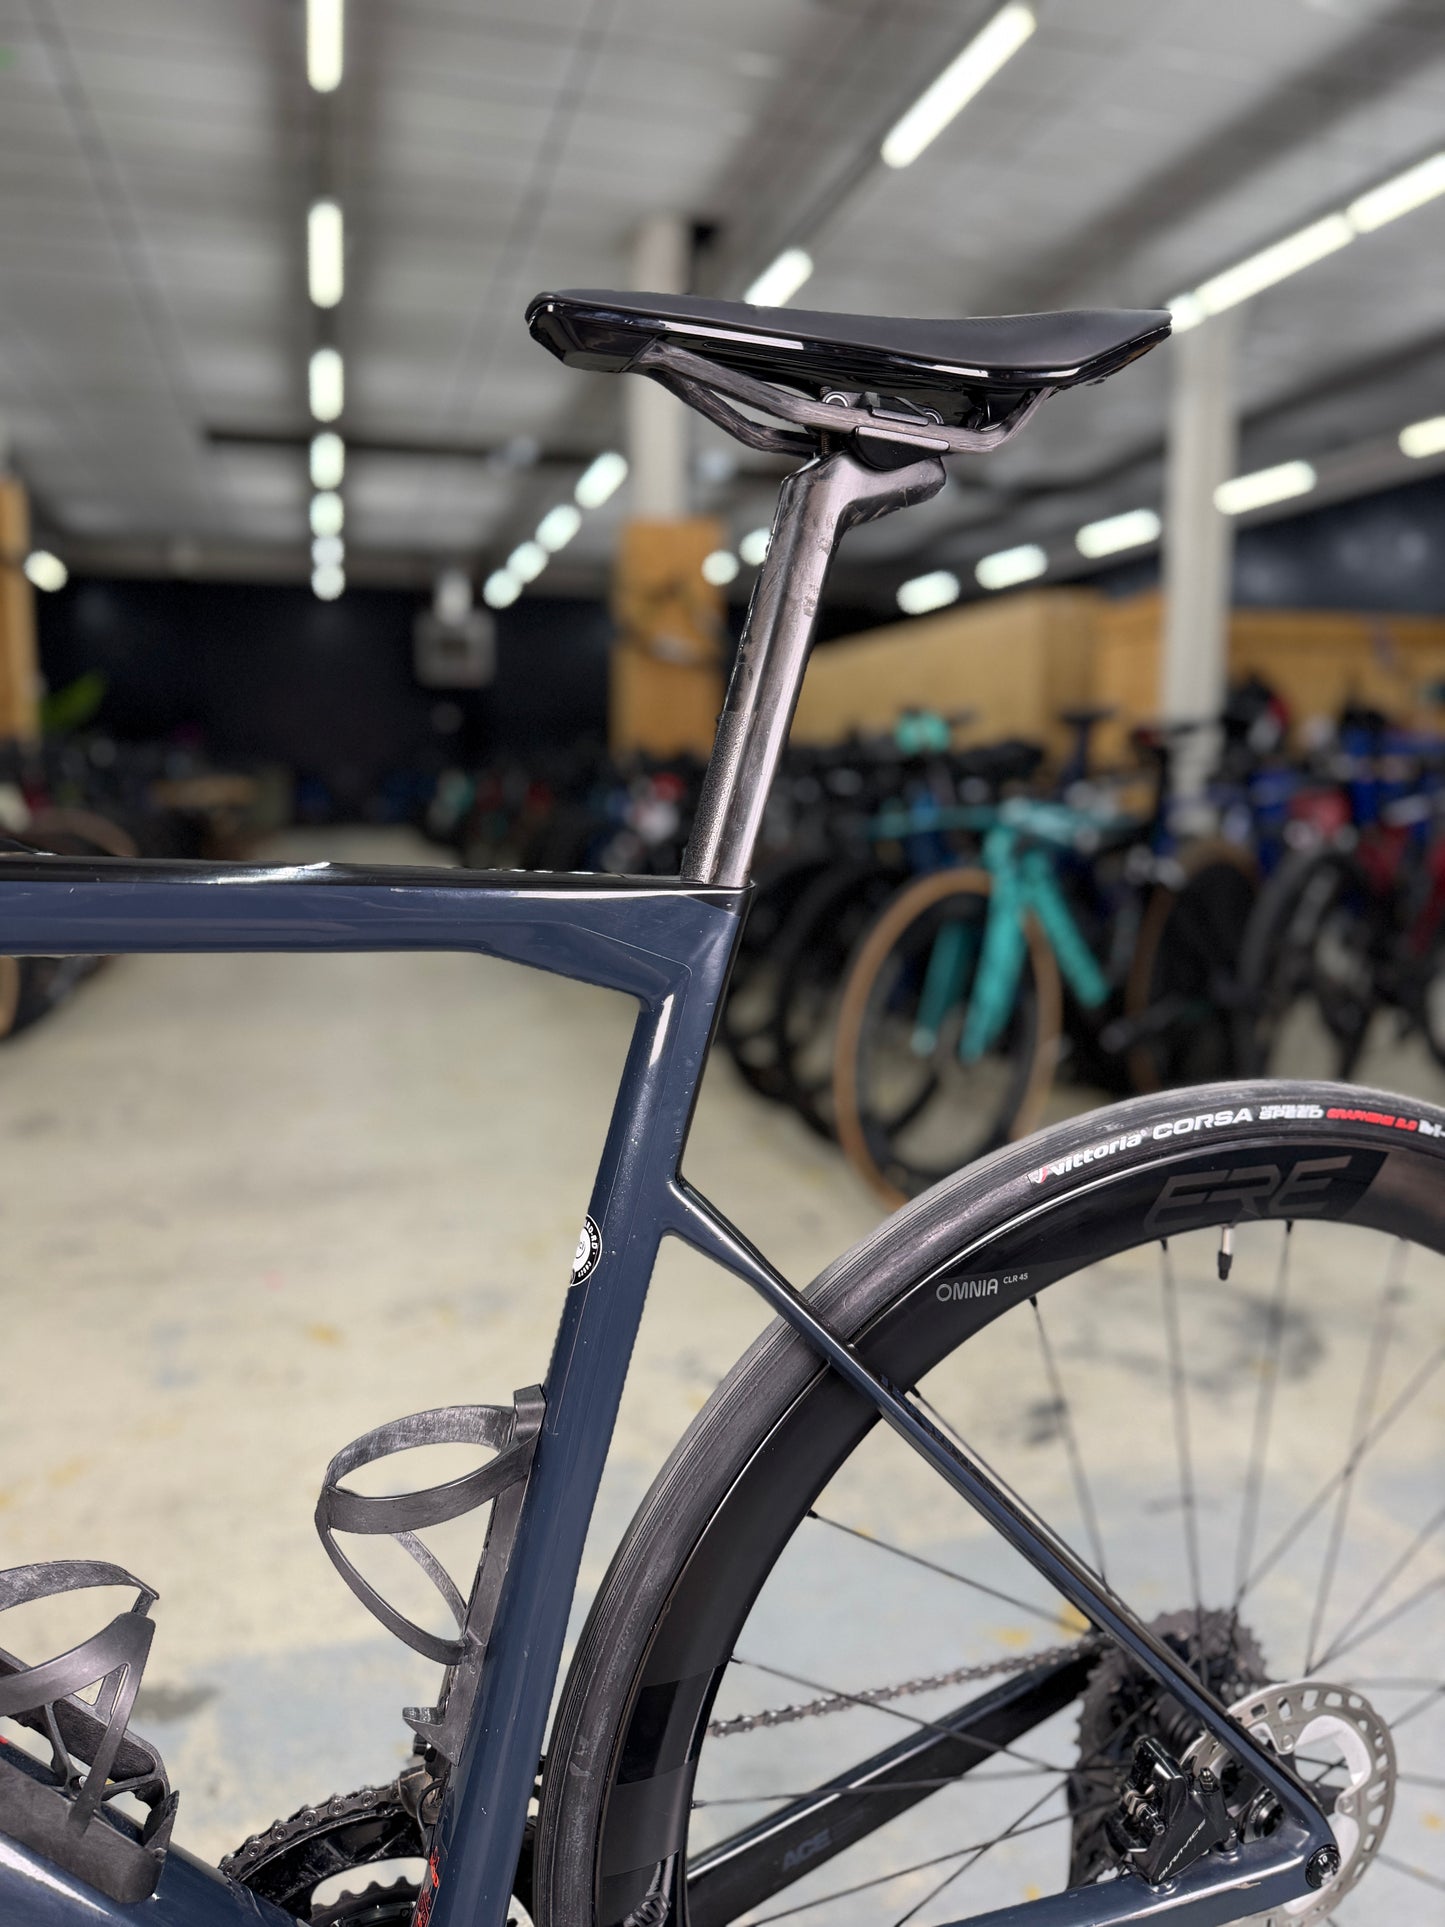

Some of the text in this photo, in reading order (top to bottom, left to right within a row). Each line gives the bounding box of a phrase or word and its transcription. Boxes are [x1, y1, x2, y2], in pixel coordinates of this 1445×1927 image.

[1152, 1108, 1254, 1140] CORSA
[1259, 1108, 1324, 1120] SPEED
[1143, 1155, 1353, 1235] ERE
[936, 1272, 1029, 1302] OMNIA CLR 45
